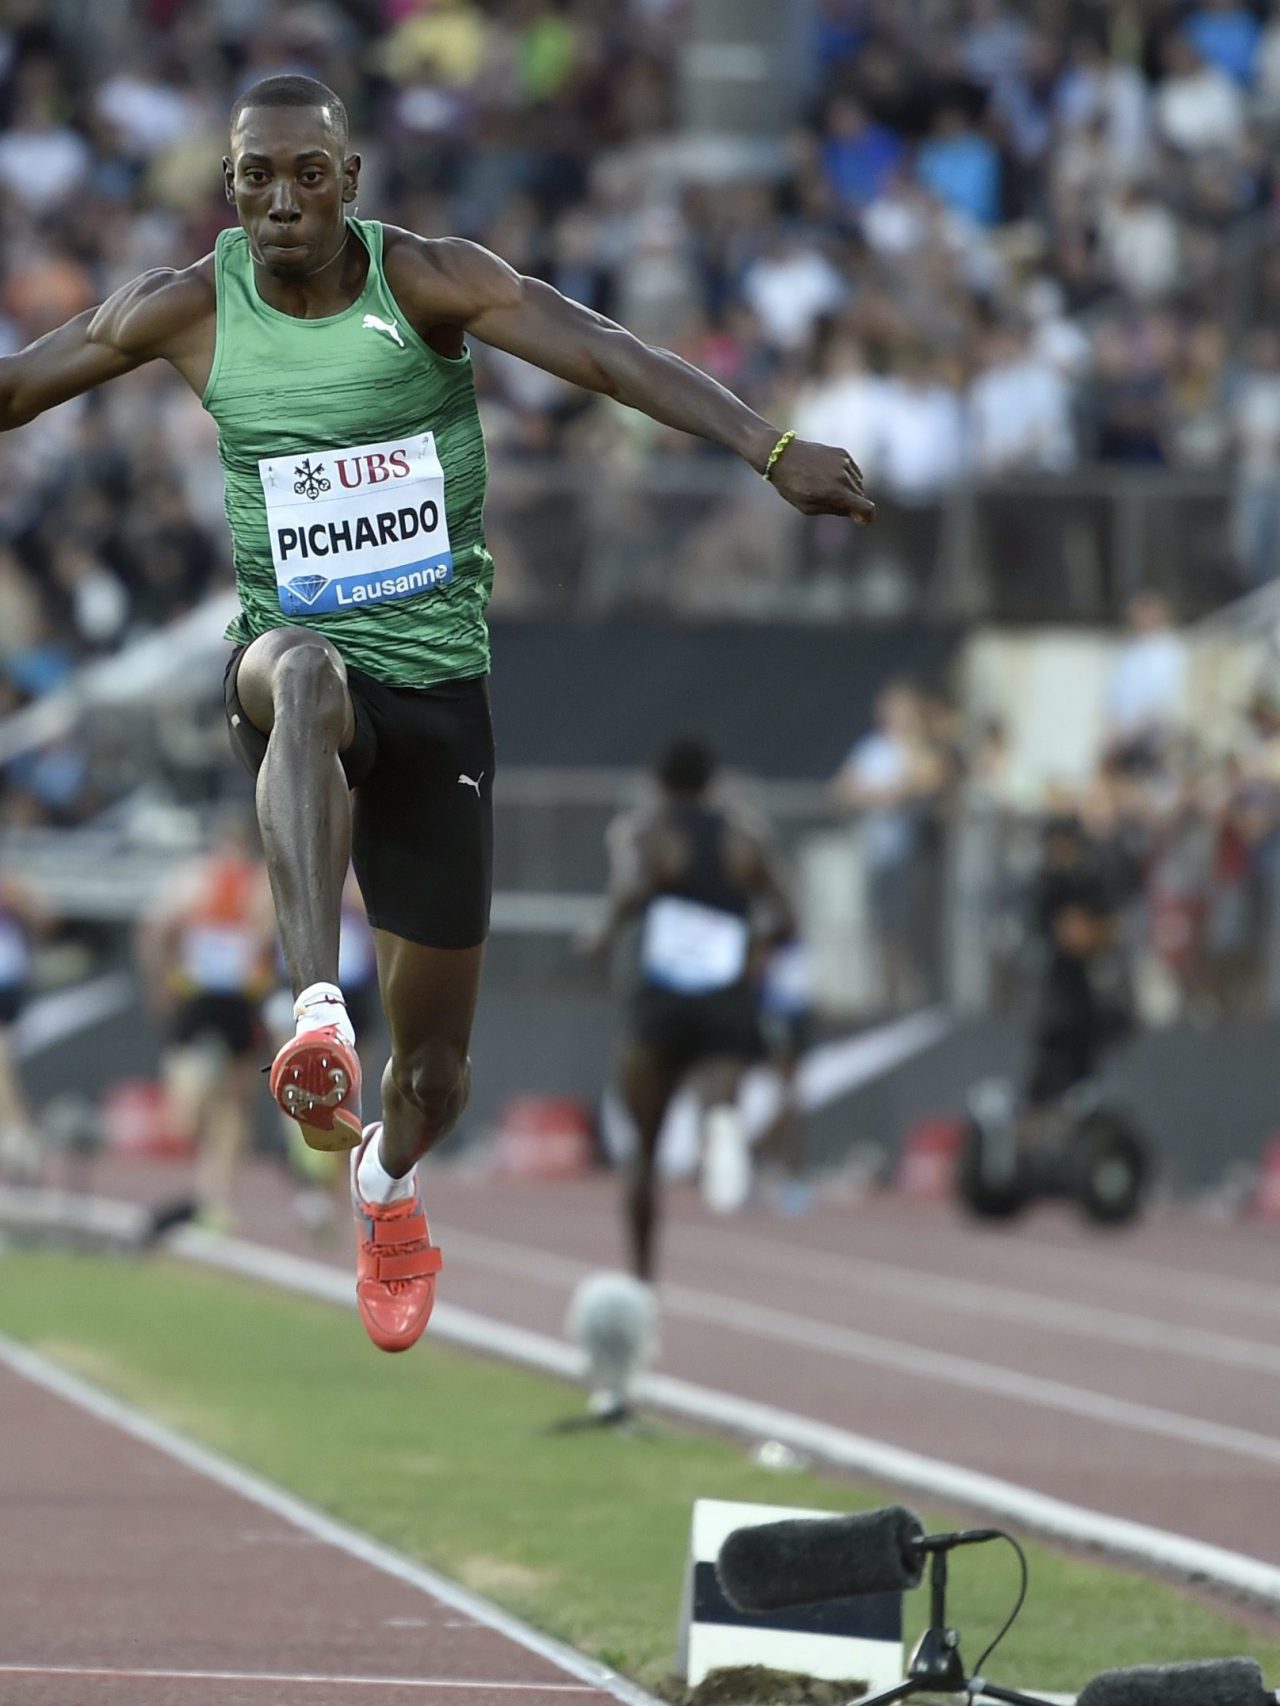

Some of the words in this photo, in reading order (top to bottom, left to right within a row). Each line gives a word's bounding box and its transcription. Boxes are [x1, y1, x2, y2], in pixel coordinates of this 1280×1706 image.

[334, 449, 410, 489] UBS
[277, 500, 438, 561] PICHARDO
[336, 564, 448, 605] Lausanne
